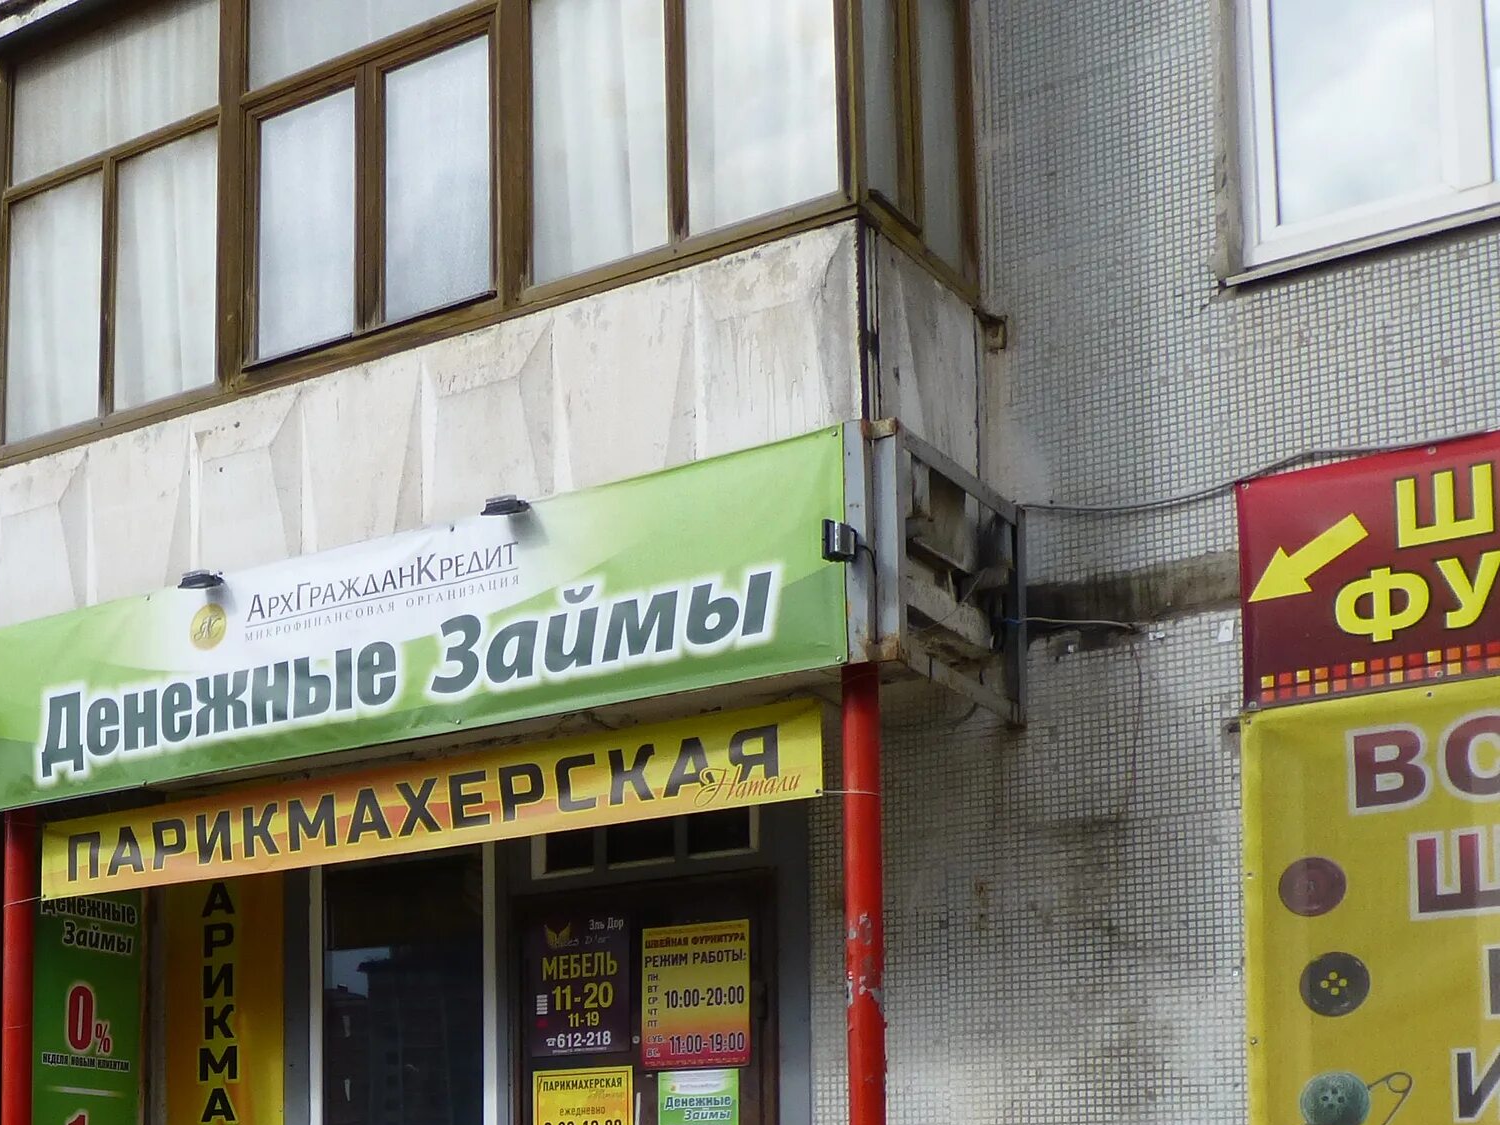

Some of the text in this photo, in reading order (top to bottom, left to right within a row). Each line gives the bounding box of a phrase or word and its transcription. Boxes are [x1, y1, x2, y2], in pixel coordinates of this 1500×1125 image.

[1394, 462, 1496, 549] Ш
[1335, 550, 1500, 642] ФУ
[244, 601, 396, 642] МИКРОФИНАНСОВАЯ
[406, 575, 520, 609] ОРГАНИЗАЦИЯ
[38, 569, 778, 779] Денежные Займы
[694, 766, 801, 807] Натали
[67, 724, 779, 883] ПАРИКМАХЕРСКАЯ
[607, 917, 624, 931] Дор
[62, 920, 133, 954] Займы
[644, 932, 746, 949] ШВЕЙНАЯ ФУРНИТУРА
[542, 952, 618, 980] МЕБЕЛЬ
[644, 949, 747, 968] РЕЖИМ РАБОТЫ:
[552, 981, 614, 1011] 11-20
[664, 985, 745, 1009] 10:00-20:00
[67, 985, 111, 1054] 0%
[568, 1011, 600, 1028] 11-19
[556, 1030, 612, 1048] 612-218
[669, 1032, 745, 1054] 11:00-19:00
[42, 1052, 69, 1066] НЕДЕЛЯ
[70, 1055, 96, 1068] НОВЫМ
[543, 1077, 622, 1092] ПАРИКМАХЕРСКАЯ
[559, 1106, 606, 1117] ежедневно
[664, 1095, 732, 1109] Денежные
[684, 1107, 731, 1121] Займы
